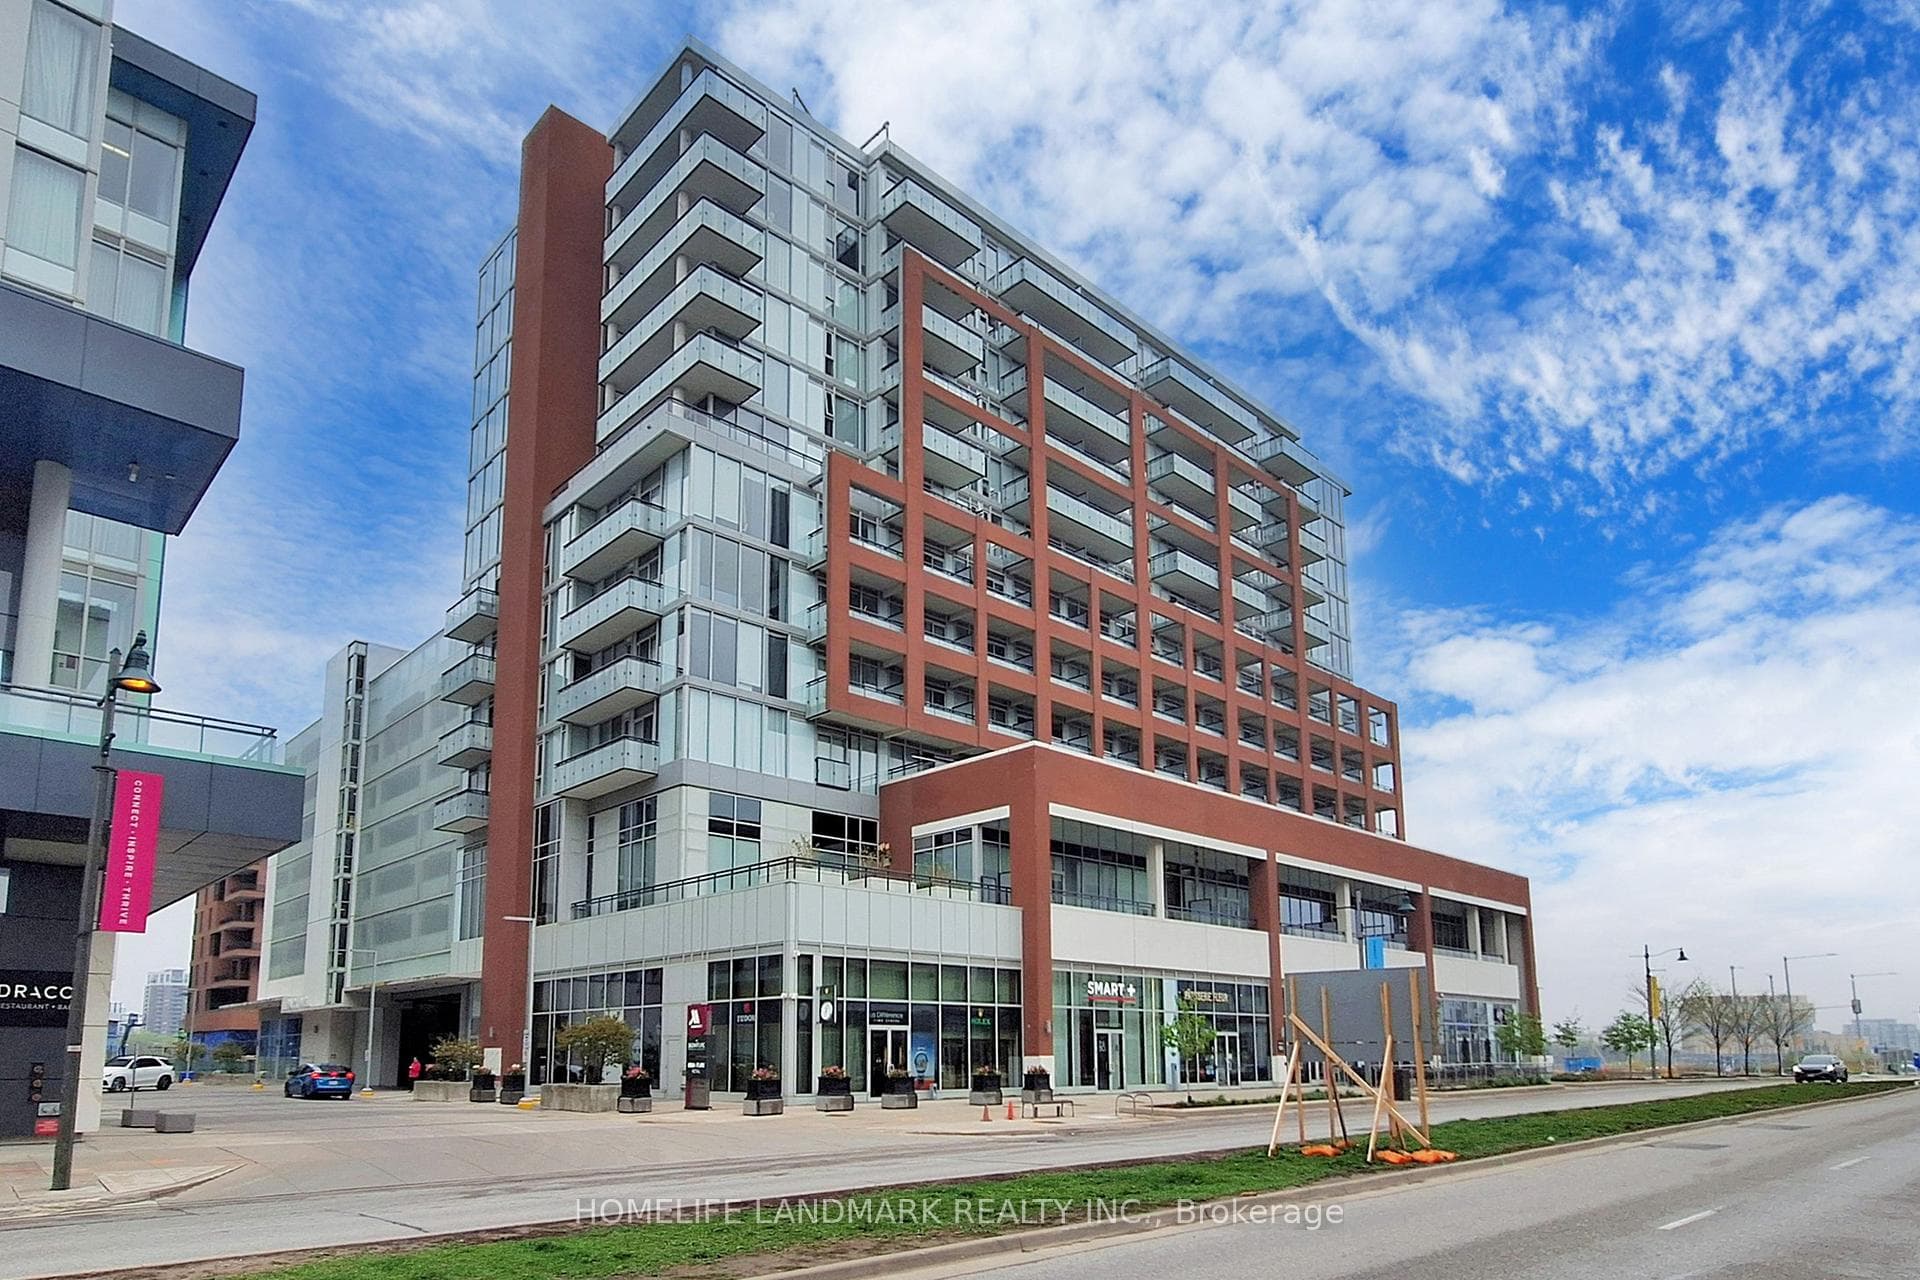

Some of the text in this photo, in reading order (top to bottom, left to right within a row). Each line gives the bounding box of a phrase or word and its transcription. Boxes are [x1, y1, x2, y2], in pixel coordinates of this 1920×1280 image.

[118, 780, 143, 925] CONNECT INSPIRE THRIVE
[1087, 981, 1125, 996] SMART
